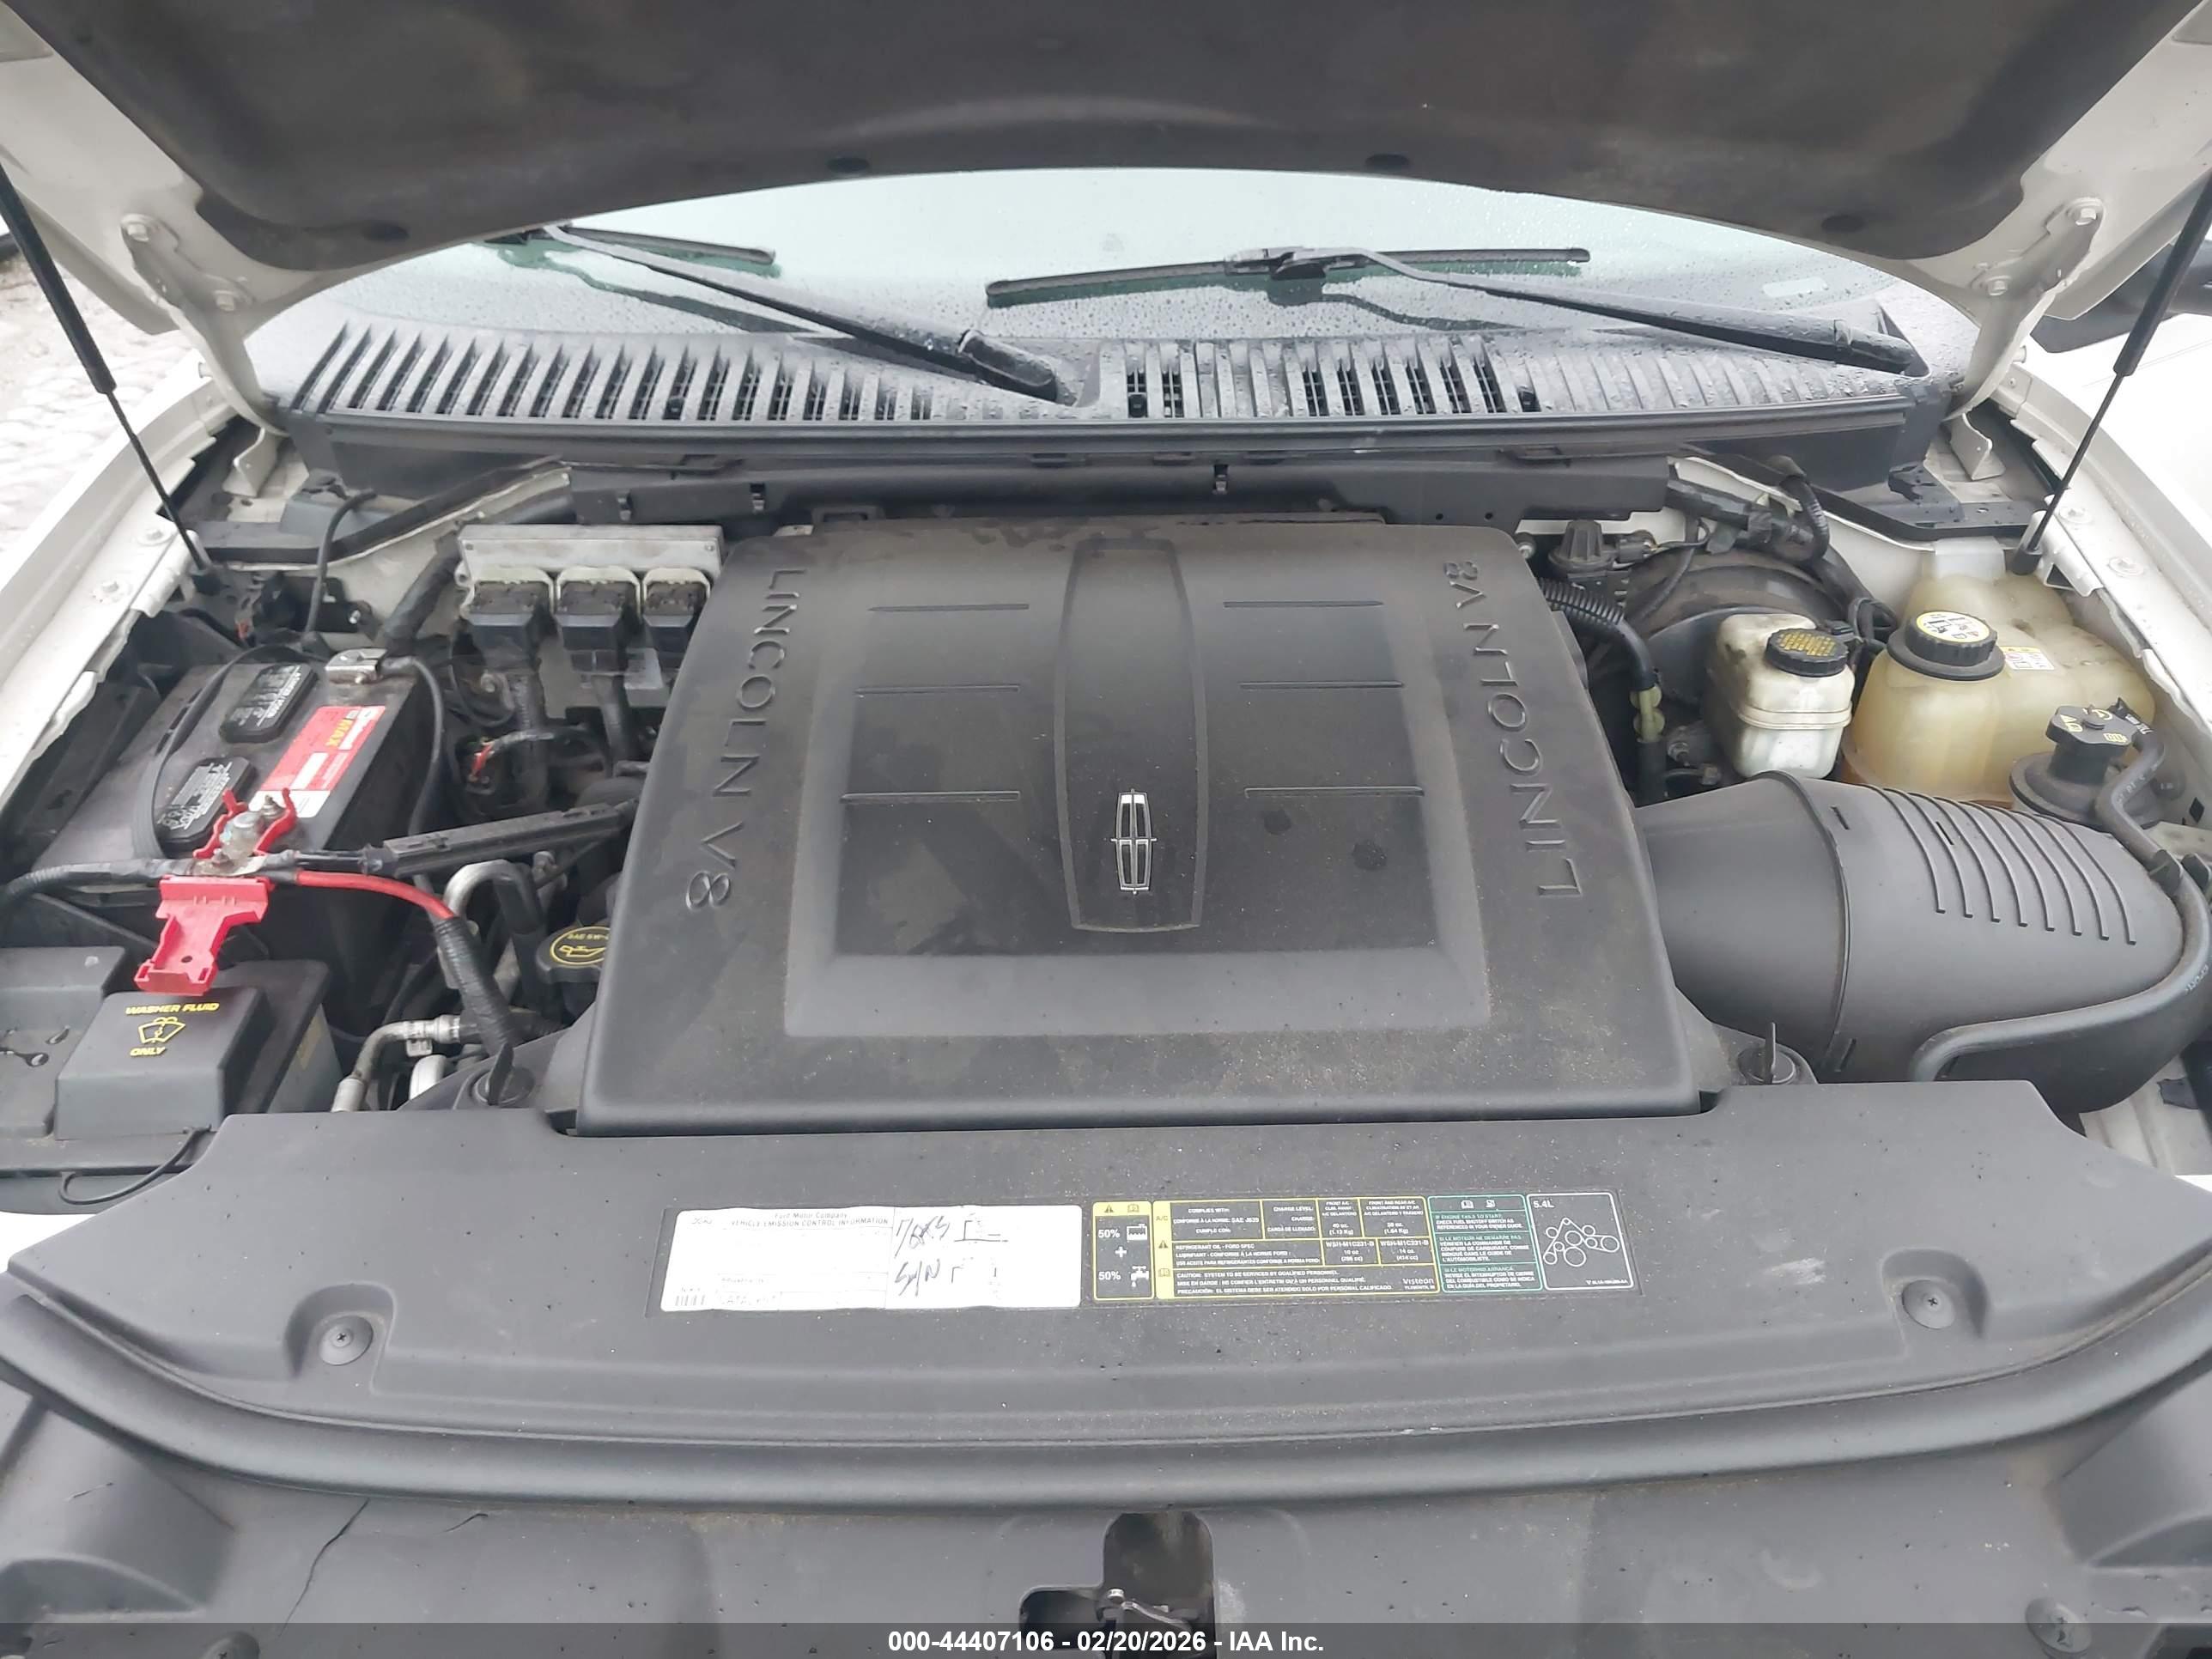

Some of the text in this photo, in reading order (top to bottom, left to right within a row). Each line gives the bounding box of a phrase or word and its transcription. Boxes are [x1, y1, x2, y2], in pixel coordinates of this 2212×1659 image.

[1443, 560, 1583, 897] LINCOLN V8
[686, 569, 806, 910] LINCOLN V8
[125, 1002, 220, 1015] WASHER FLUID
[130, 1046, 166, 1057] ONLY
[1533, 1200, 1555, 1208] 5.4L
[1097, 1229, 1121, 1238] 50%
[1098, 1271, 1121, 1280] 50%
